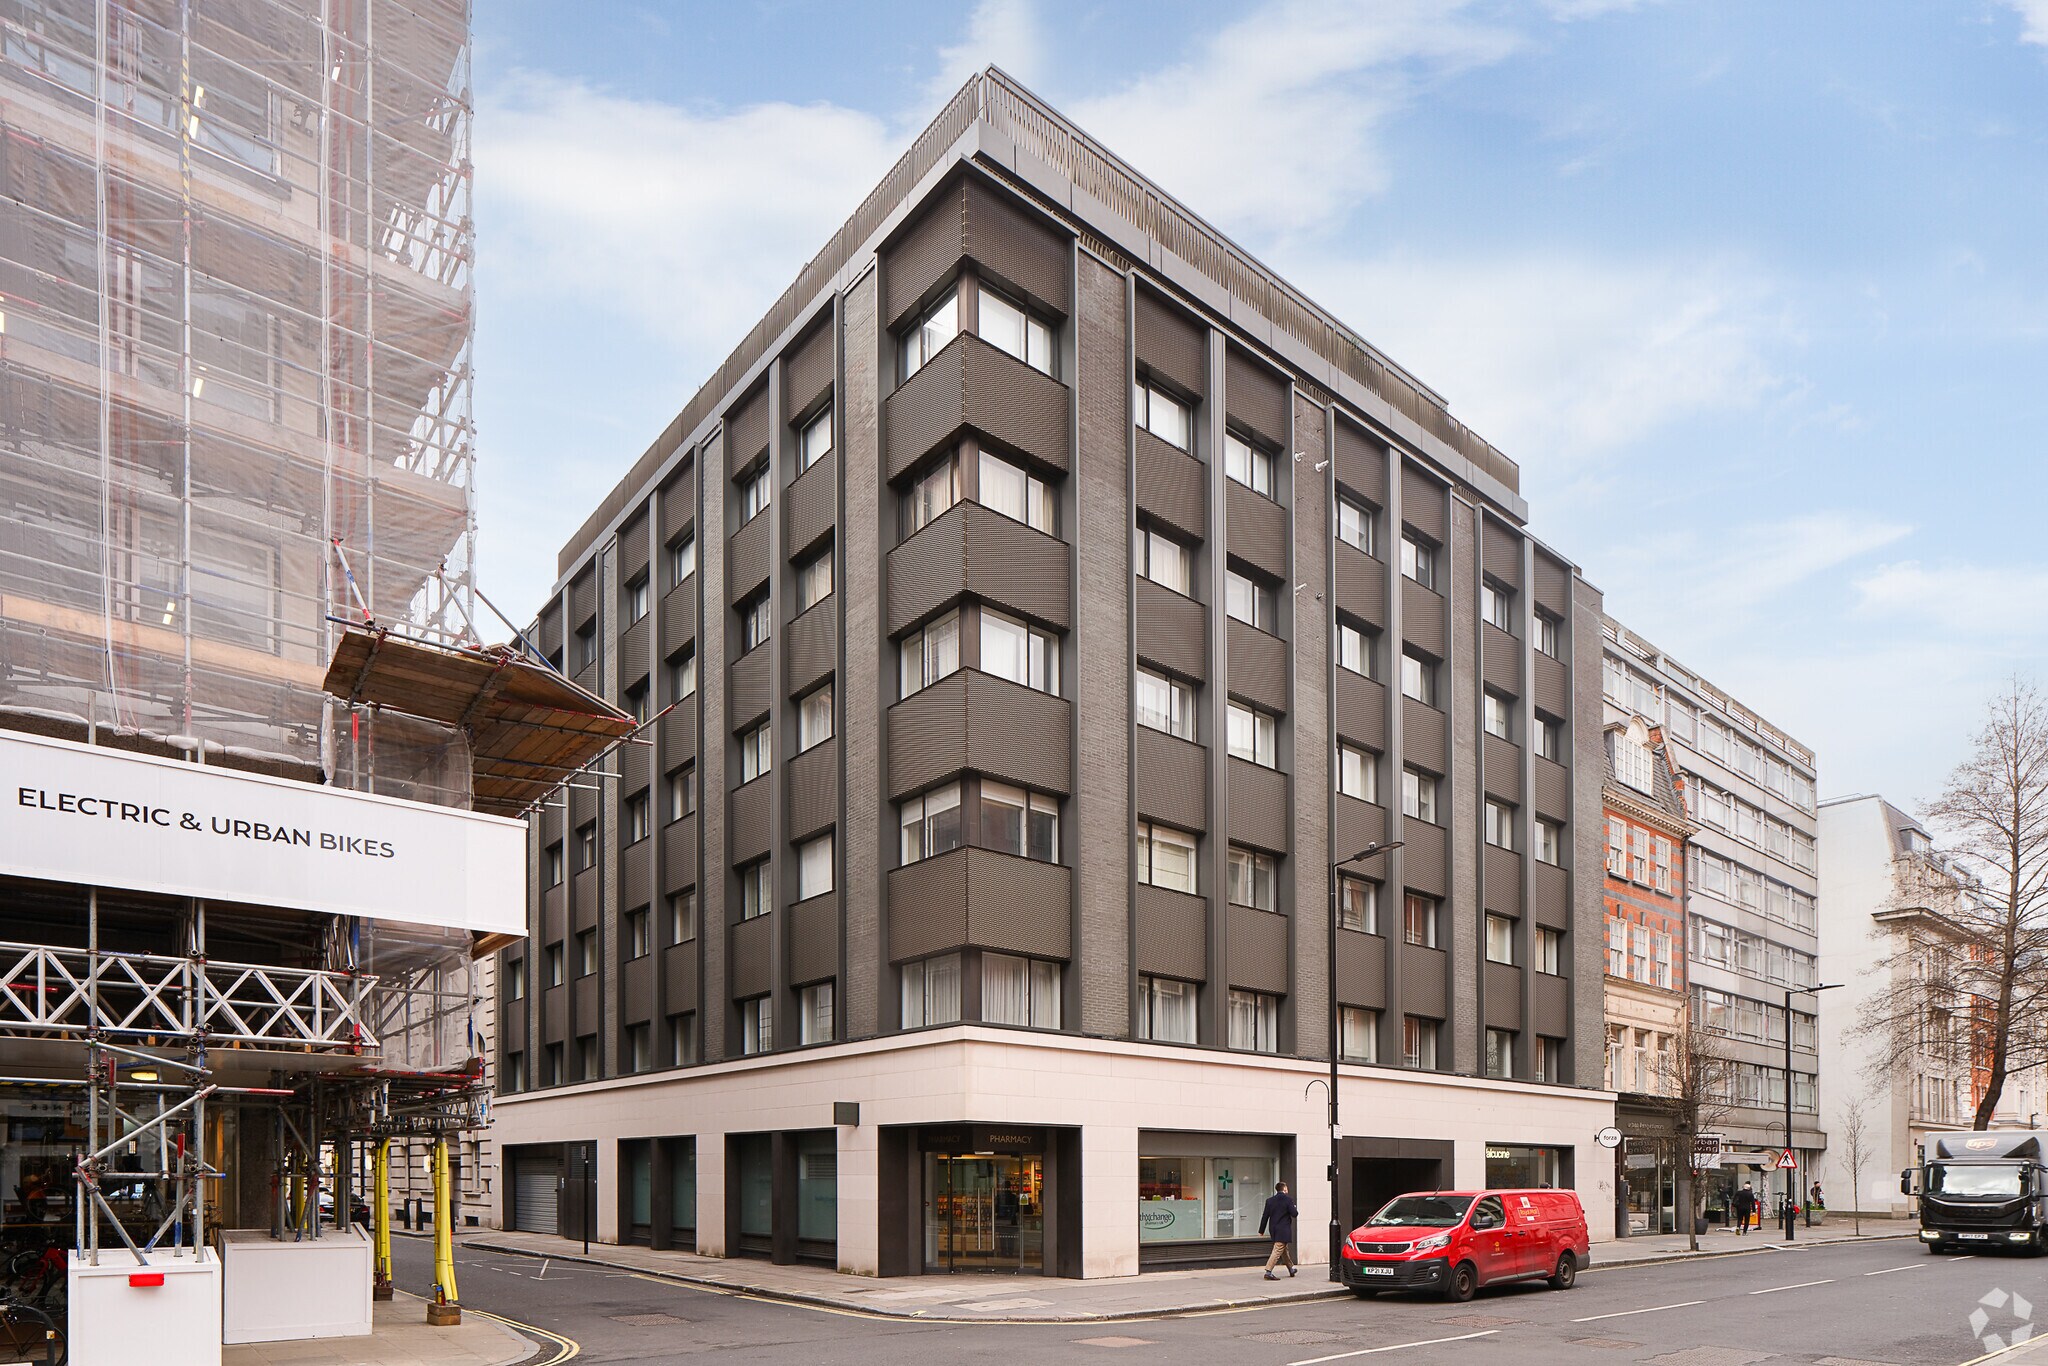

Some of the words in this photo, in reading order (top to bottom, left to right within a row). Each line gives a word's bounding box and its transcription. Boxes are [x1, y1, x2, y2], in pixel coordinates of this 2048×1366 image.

[18, 786, 171, 827] ELECTRIC
[179, 812, 202, 832] &
[211, 816, 311, 848] URBAN
[319, 832, 395, 859] BIKES
[989, 1134, 1032, 1144] PHARMACY
[1970, 1140, 1994, 1149] ups
